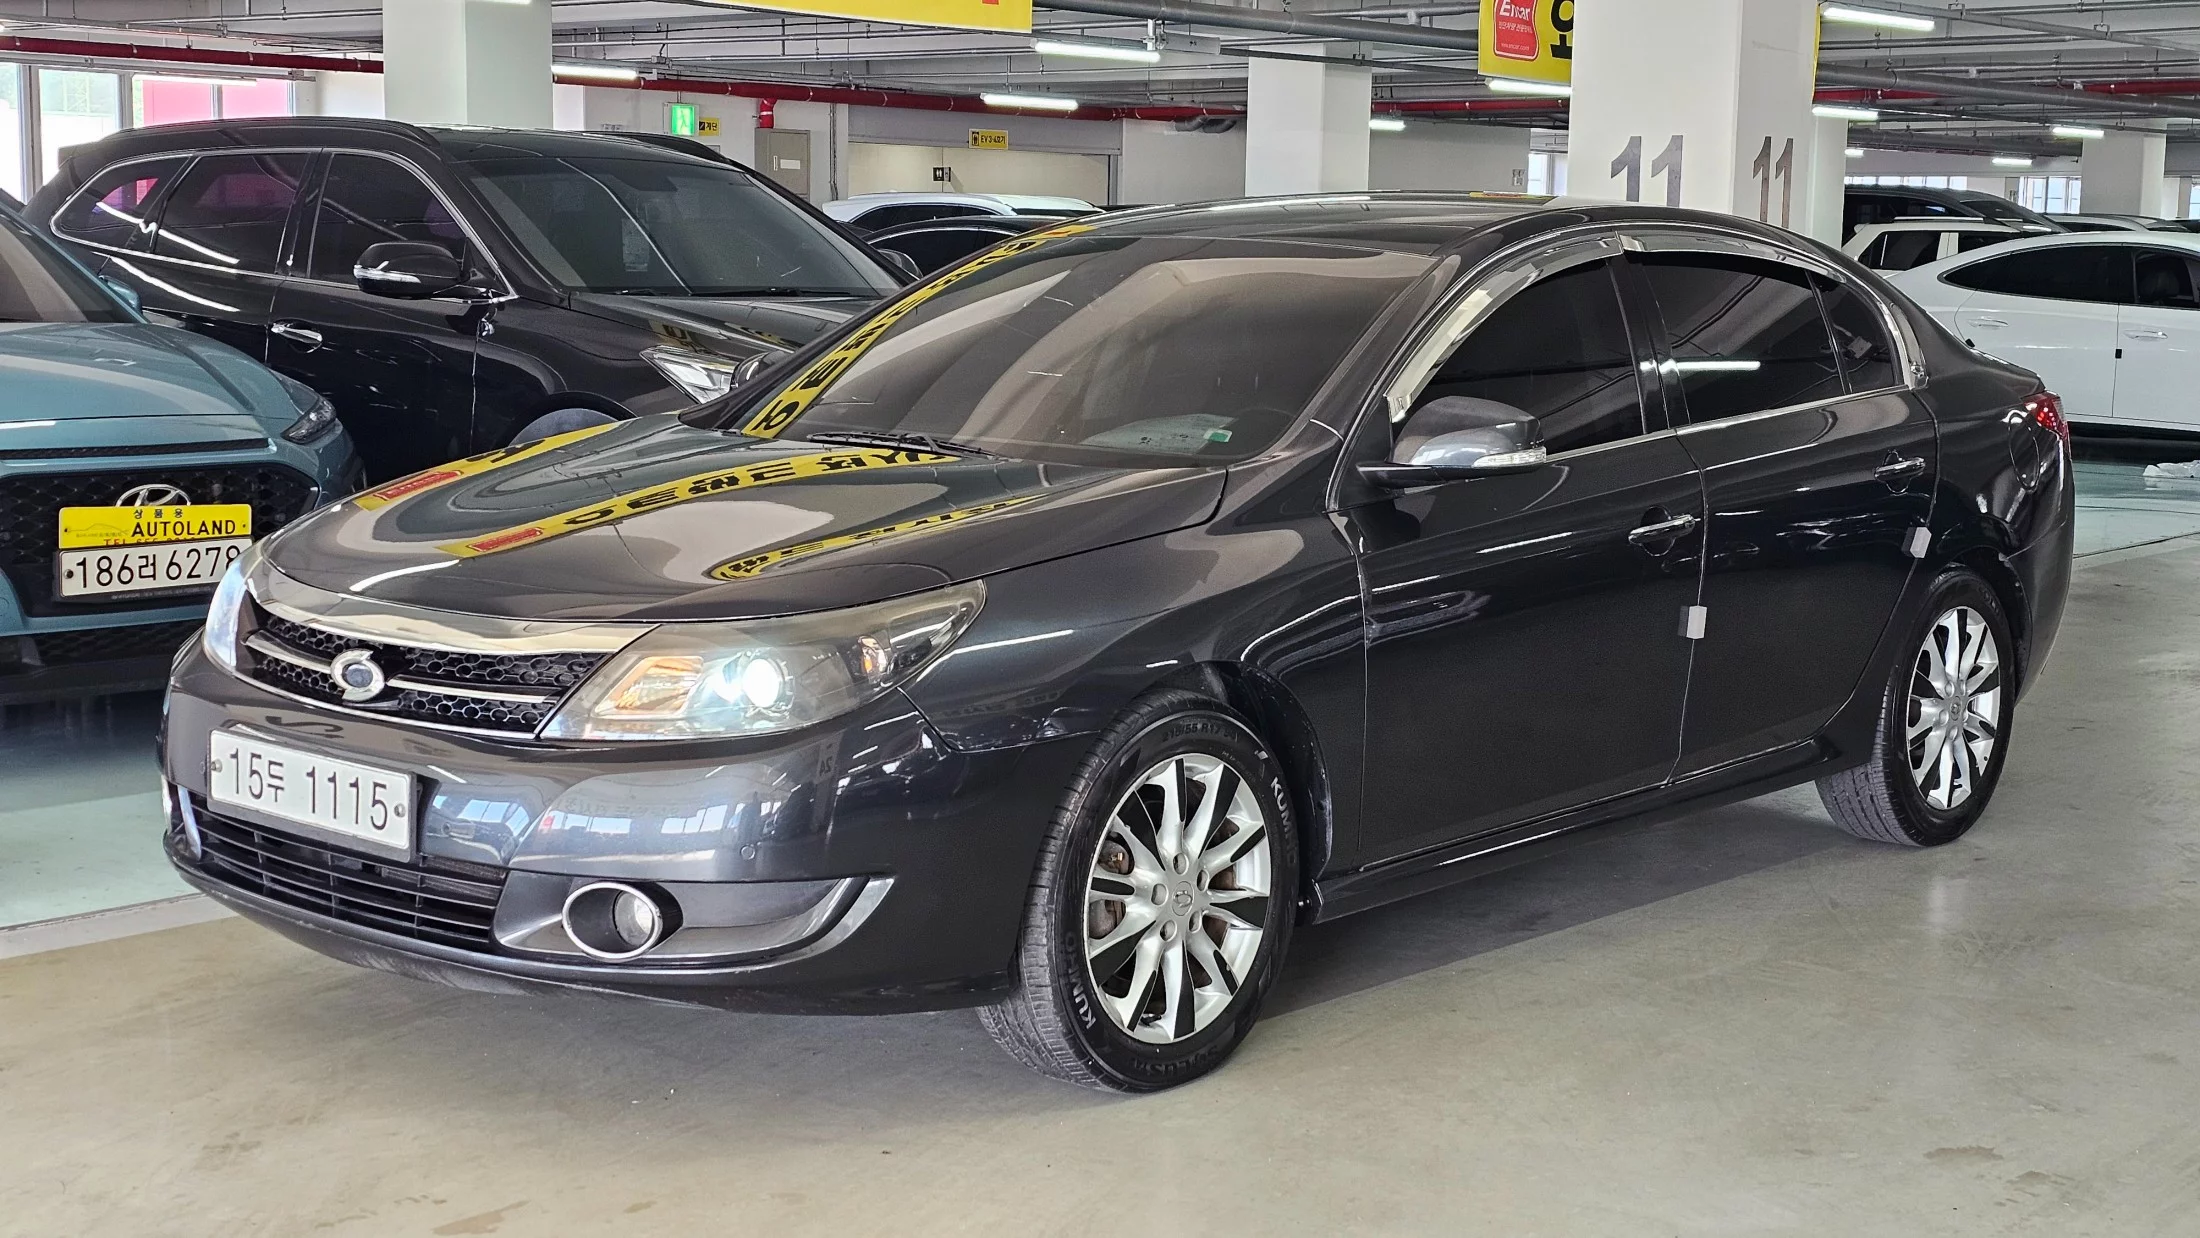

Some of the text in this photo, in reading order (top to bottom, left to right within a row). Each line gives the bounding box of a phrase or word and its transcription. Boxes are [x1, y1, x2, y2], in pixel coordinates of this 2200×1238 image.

[1500, 0, 1531, 21] Encar
[705, 121, 718, 131] 계단
[980, 135, 988, 143] EV
[1610, 134, 1683, 208] 11
[1753, 135, 1794, 229] 11
[131, 520, 236, 538] AUTOLAND
[76, 553, 157, 589] 186러
[229, 748, 389, 831] 15두 1115
